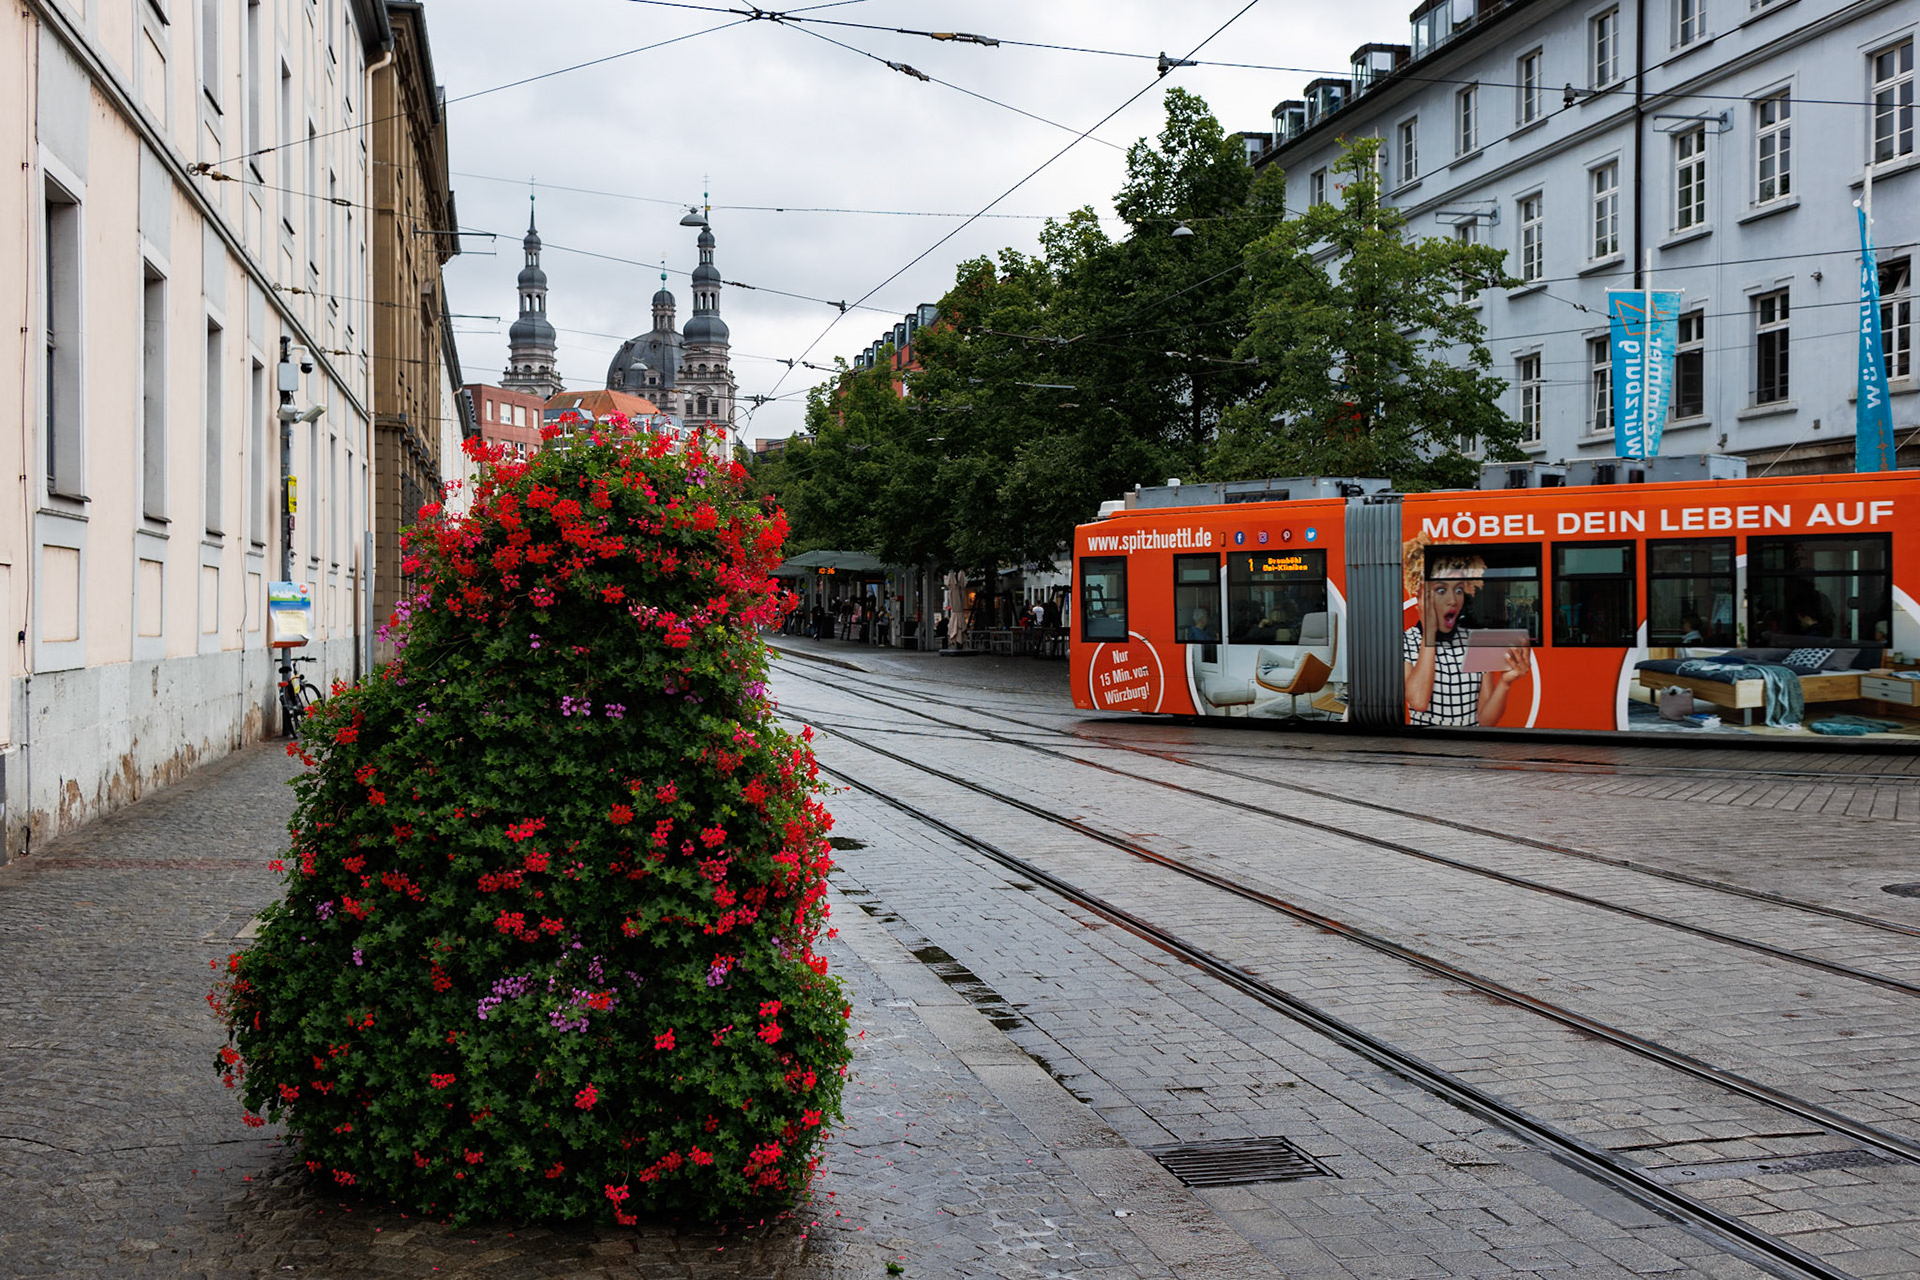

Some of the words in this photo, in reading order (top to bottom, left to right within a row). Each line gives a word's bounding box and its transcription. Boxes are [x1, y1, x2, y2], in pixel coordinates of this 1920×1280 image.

[1422, 511, 1544, 539] MÖBEL
[1557, 509, 1646, 535] DEIN
[1660, 504, 1791, 532] LEBEN
[1806, 500, 1894, 526] AUF
[1088, 527, 1212, 554] www.spitzhuettl.de
[1248, 558, 1254, 572] 1
[1112, 649, 1128, 664] Nur
[1099, 672, 1111, 687] 15
[1112, 668, 1133, 684] Min.
[1132, 665, 1149, 679] von
[1104, 682, 1150, 705] Würzburg!
